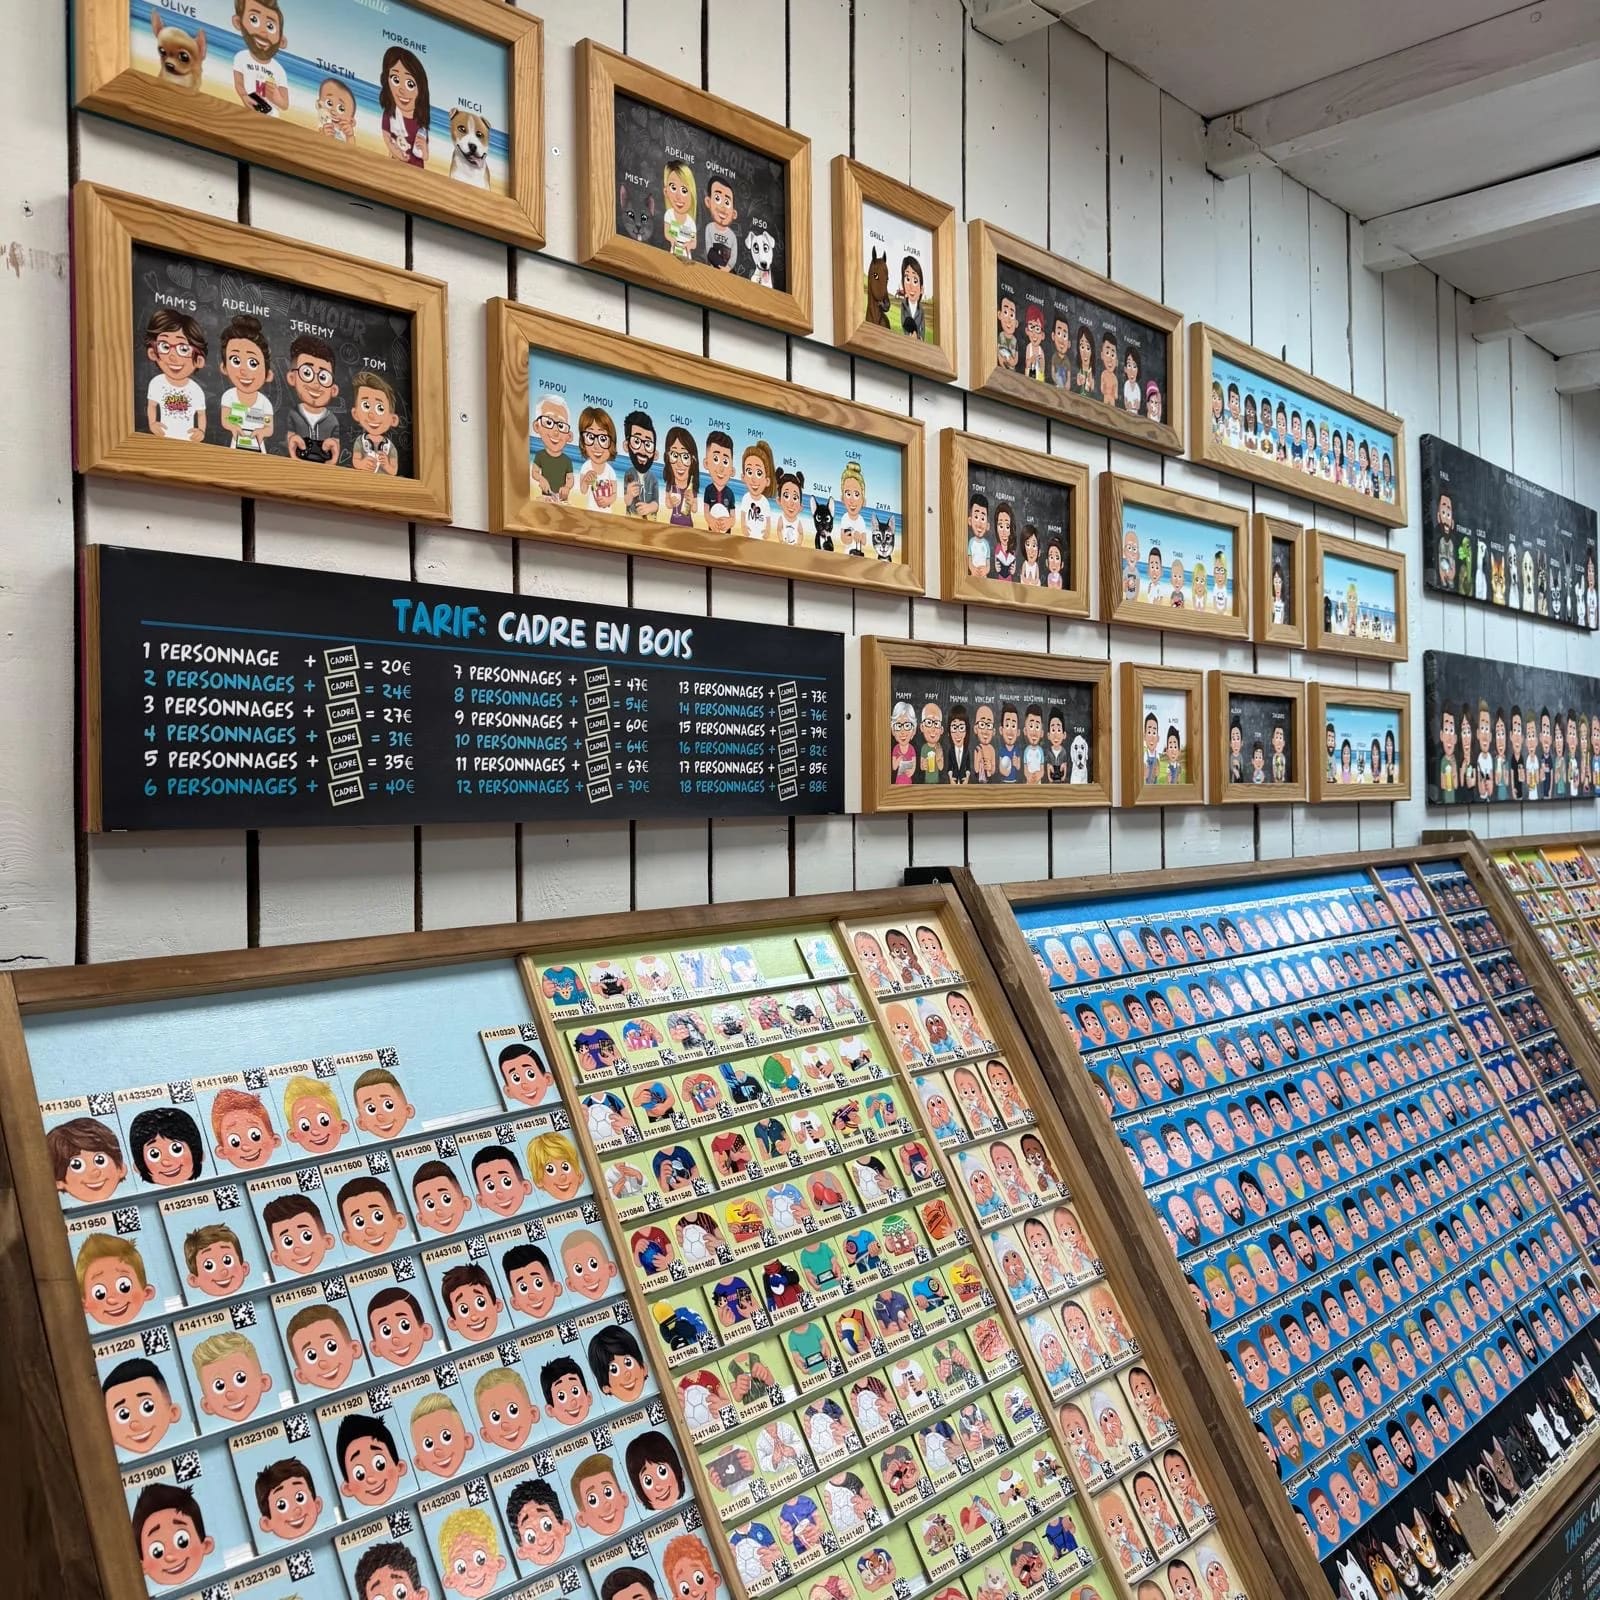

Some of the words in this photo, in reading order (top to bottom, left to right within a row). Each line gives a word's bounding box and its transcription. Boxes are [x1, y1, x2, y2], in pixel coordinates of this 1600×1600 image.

[161, 0, 196, 17] OLIVE
[382, 28, 427, 54] MORGANE
[316, 57, 356, 80] JUSTIN
[457, 96, 483, 113] NICCI
[665, 145, 695, 165] ADELINE
[705, 160, 736, 180] QUENTIN
[625, 172, 649, 188] MISTY
[752, 217, 767, 229] IPSO
[155, 292, 197, 311] MAM'S
[222, 298, 270, 317] ADELINE
[289, 319, 335, 338] JEREMY
[363, 357, 386, 371] TOM
[539, 379, 567, 393] PAPOU
[583, 393, 613, 408] MAMOU
[633, 399, 648, 409] FLO
[708, 417, 731, 431] DAM'S
[813, 482, 832, 493] SULLY
[393, 599, 486, 638] TARIF:
[498, 612, 587, 649] CADRE
[596, 621, 630, 654] EN
[639, 625, 693, 660] BOIS
[143, 642, 150, 658] 1
[161, 643, 279, 666] PERSONNAGE
[330, 653, 354, 665] CADRE
[381, 660, 411, 675] 20€
[144, 670, 156, 686] 2
[167, 670, 295, 693] PERSONNAGES
[330, 679, 355, 691] CADRE
[383, 684, 411, 699] 24€
[454, 664, 462, 679] 7
[470, 666, 562, 686] PERSONNAGES
[627, 678, 648, 691] 47€
[455, 687, 464, 702] 8
[471, 688, 562, 708] PERSONNAGES
[626, 697, 648, 712] 54€
[679, 681, 689, 694] 13
[694, 682, 763, 699] PERSONNAGES
[811, 690, 827, 703] 73€
[144, 695, 154, 713] 3
[165, 696, 294, 719] PERSONNAGES
[331, 707, 356, 719] CADRE
[383, 708, 412, 723] 27€
[679, 702, 689, 715] 14
[695, 703, 764, 718] PERSONNAGES
[810, 709, 827, 721] 76€
[455, 710, 464, 725] 9
[472, 711, 563, 730] PERSONNAGES
[626, 719, 648, 732] 60€
[679, 721, 691, 733] 15
[696, 722, 765, 737] PERSONNAGES
[811, 727, 827, 738] 79€
[144, 725, 155, 741] 4
[168, 724, 296, 744] PERSONNAGES
[332, 733, 357, 745] CADRE
[389, 731, 412, 746] 31€
[455, 734, 470, 748] 10
[477, 734, 567, 751] PERSONNAGES
[627, 740, 648, 753] 64€
[679, 742, 690, 754] 16
[695, 741, 764, 755] PERSONNAGES
[810, 745, 827, 756] 82€
[144, 750, 158, 766] 5
[169, 750, 297, 770] PERSONNAGES
[333, 759, 358, 771] CADRE
[385, 754, 414, 770] 35€
[456, 757, 467, 771] 11
[474, 756, 565, 772] PERSONNAGES
[628, 760, 648, 773] 67€
[679, 761, 690, 773] 17
[695, 760, 763, 774] PERSONNAGES
[809, 762, 827, 774] 85€
[145, 779, 157, 796] 6
[168, 777, 297, 795] PERSONNAGES
[334, 785, 359, 797] CADRE
[386, 779, 414, 794] 40€
[457, 780, 472, 793] 12
[479, 779, 569, 794] PERSONNAGES
[628, 780, 649, 793] 70€
[680, 780, 692, 793] 18
[696, 780, 764, 793] PERSONNAGES
[810, 781, 826, 792] 88€
[336, 1053, 373, 1066] 41411250
[269, 1064, 309, 1077] 41431930
[584, 1070, 613, 1081] 51411210
[196, 1075, 239, 1089] 41411960
[117, 1088, 163, 1102] 41433520
[395, 1144, 432, 1159] 41411200
[323, 1160, 363, 1176] 41411600
[250, 1176, 292, 1192] 41411100
[721, 1174, 747, 1187] 51411410
[164, 1195, 209, 1212] 41323150
[665, 1190, 692, 1204] 51411540
[546, 1211, 578, 1225] 41411430
[487, 1228, 522, 1244] 41411120
[426, 1245, 462, 1262] 41443100
[348, 1266, 388, 1284] 41410300
[687, 1259, 716, 1273] 51411402
[275, 1286, 317, 1304] 41411650
[178, 1312, 225, 1332] 41411130
[520, 1329, 554, 1347] 41323120
[724, 1324, 751, 1341] 51411210
[458, 1352, 495, 1371] 41411630
[391, 1376, 431, 1395] 41411230
[321, 1397, 363, 1418] 41411920
[740, 1402, 769, 1418] 51411340
[611, 1411, 644, 1431] 41413500
[233, 1427, 279, 1448] 41323100
[554, 1436, 589, 1457] 41431050
[493, 1462, 531, 1484] 41432020
[421, 1490, 461, 1513] 41432030
[340, 1522, 383, 1546] 41412000
[233, 1565, 282, 1591] 41323130
